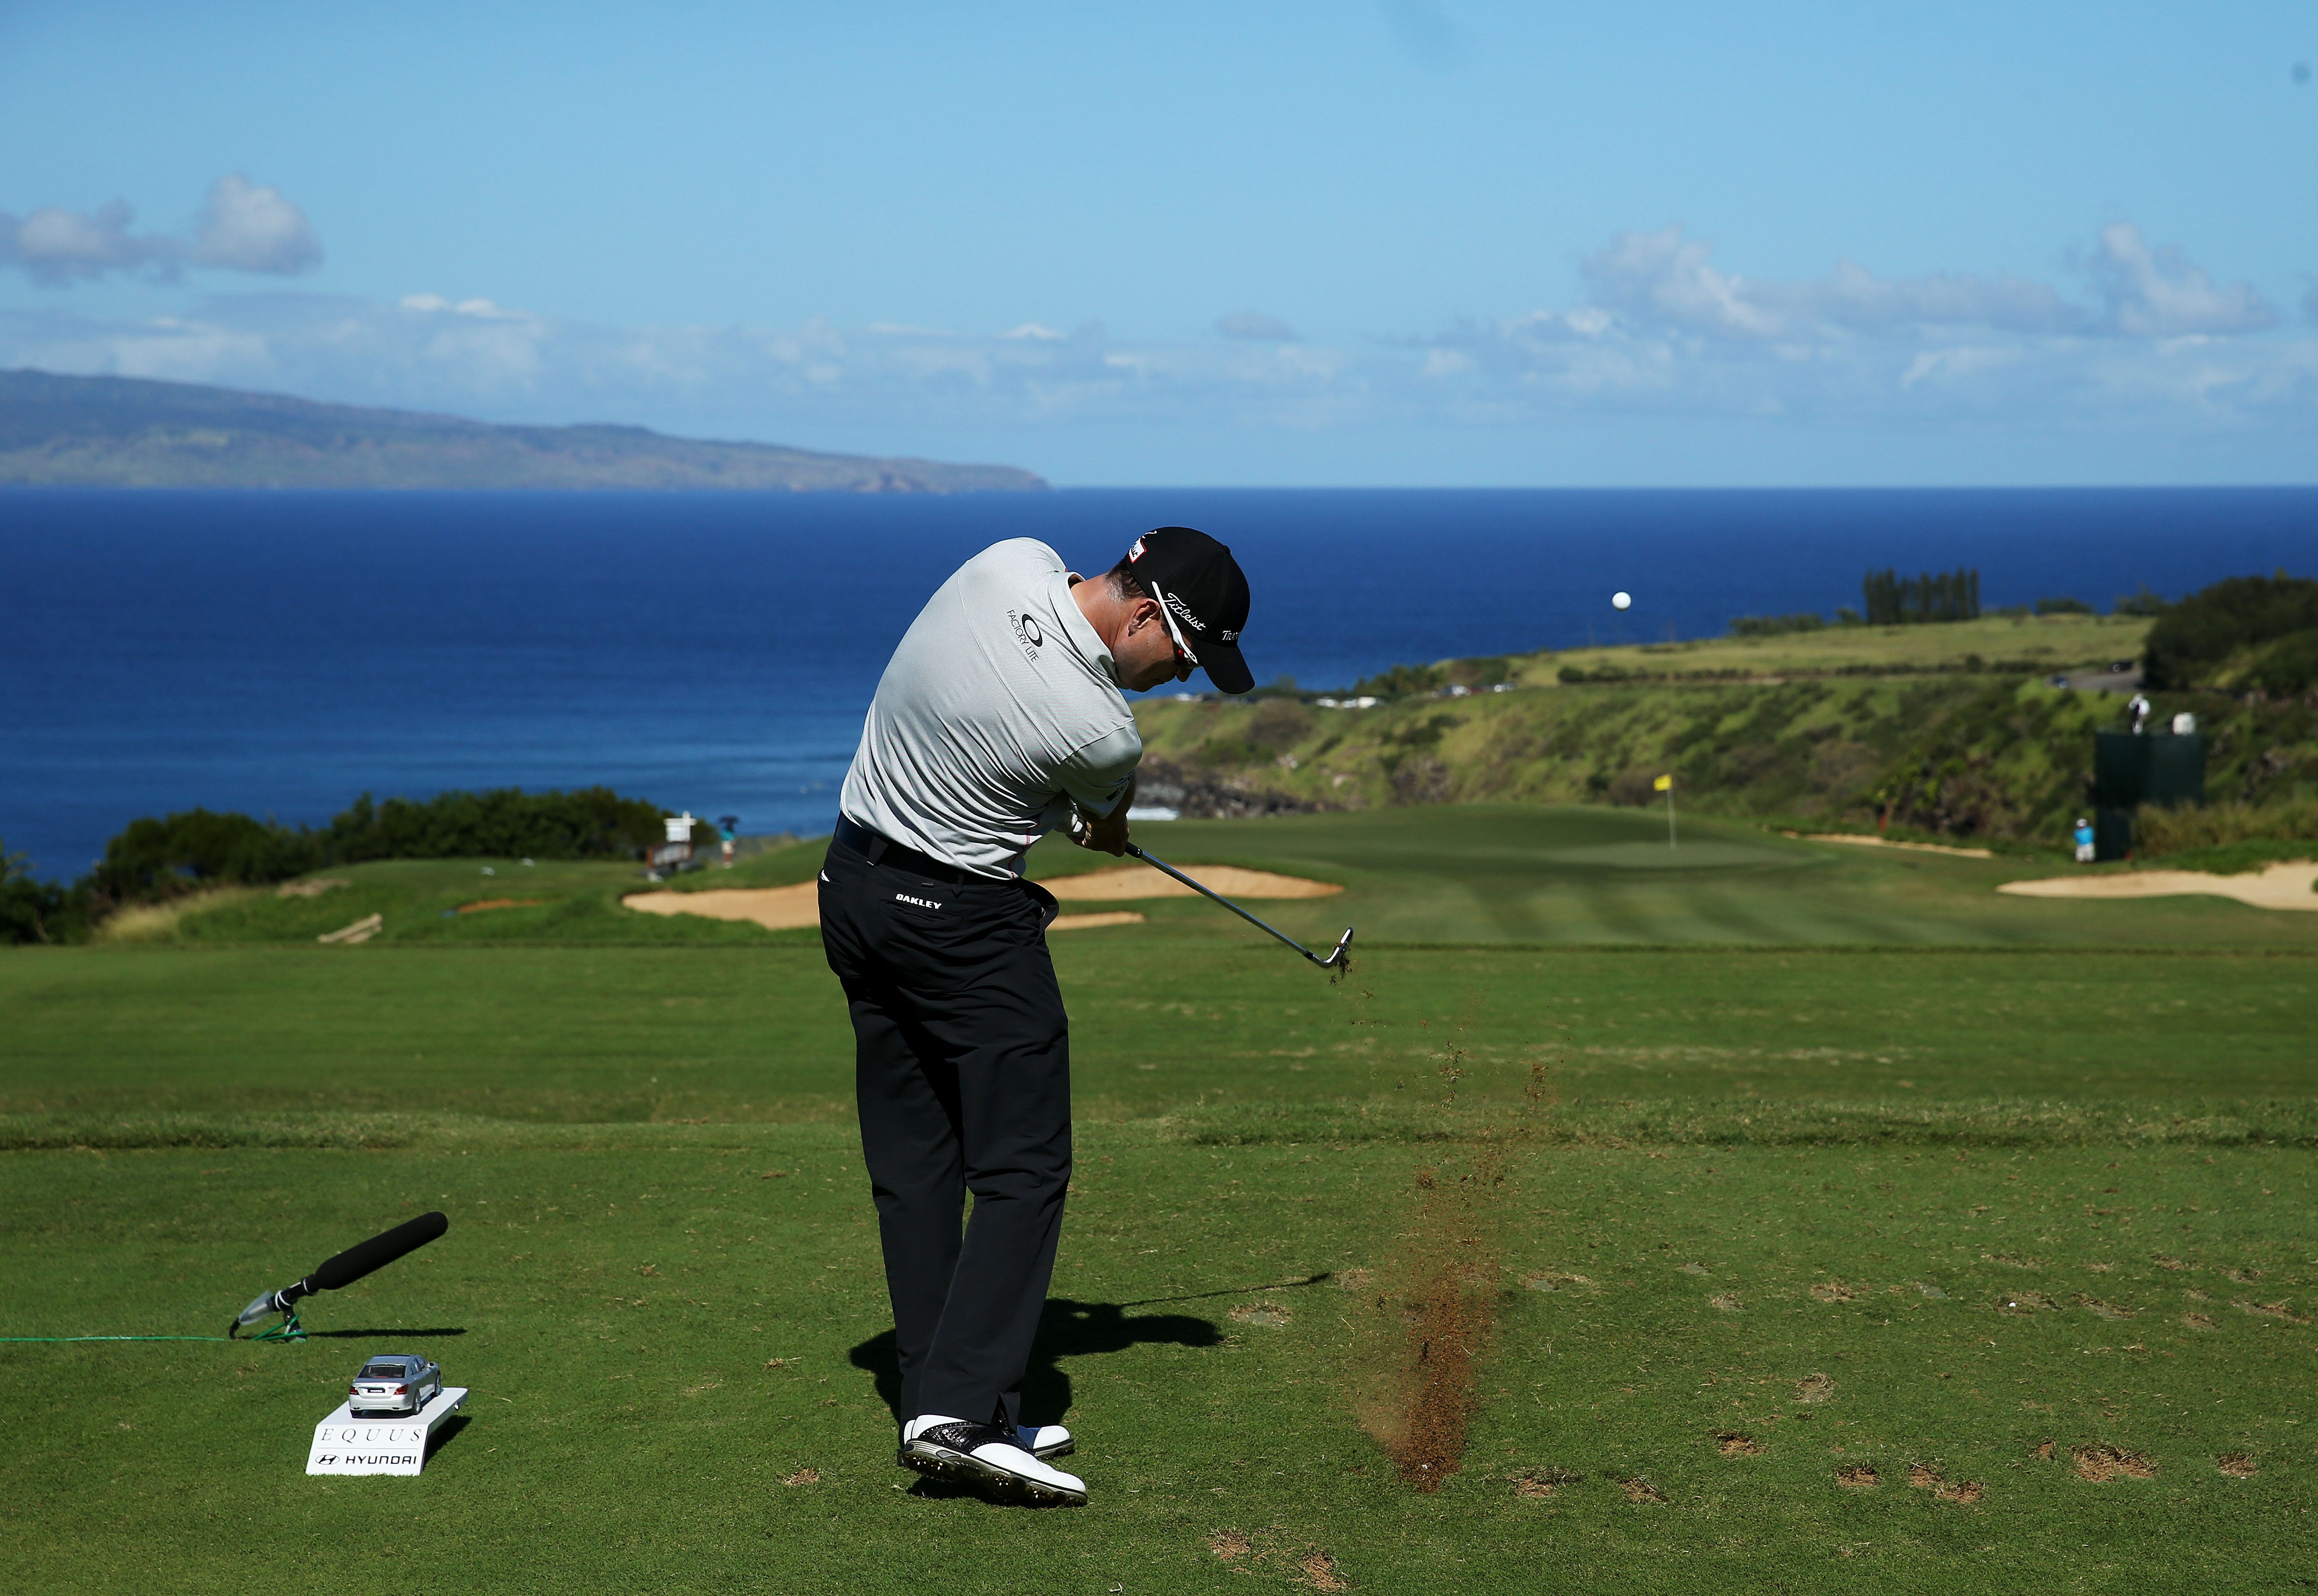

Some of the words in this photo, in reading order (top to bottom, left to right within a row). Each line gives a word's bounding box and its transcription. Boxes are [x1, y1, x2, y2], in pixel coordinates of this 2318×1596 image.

[1163, 593, 1205, 630] Titleist
[1006, 610, 1029, 645] FACTORY
[1025, 646, 1039, 662] LITE
[896, 893, 942, 909] OAKLEY
[321, 1428, 421, 1444] EQUUS
[346, 1455, 417, 1464] HYUNDAI
